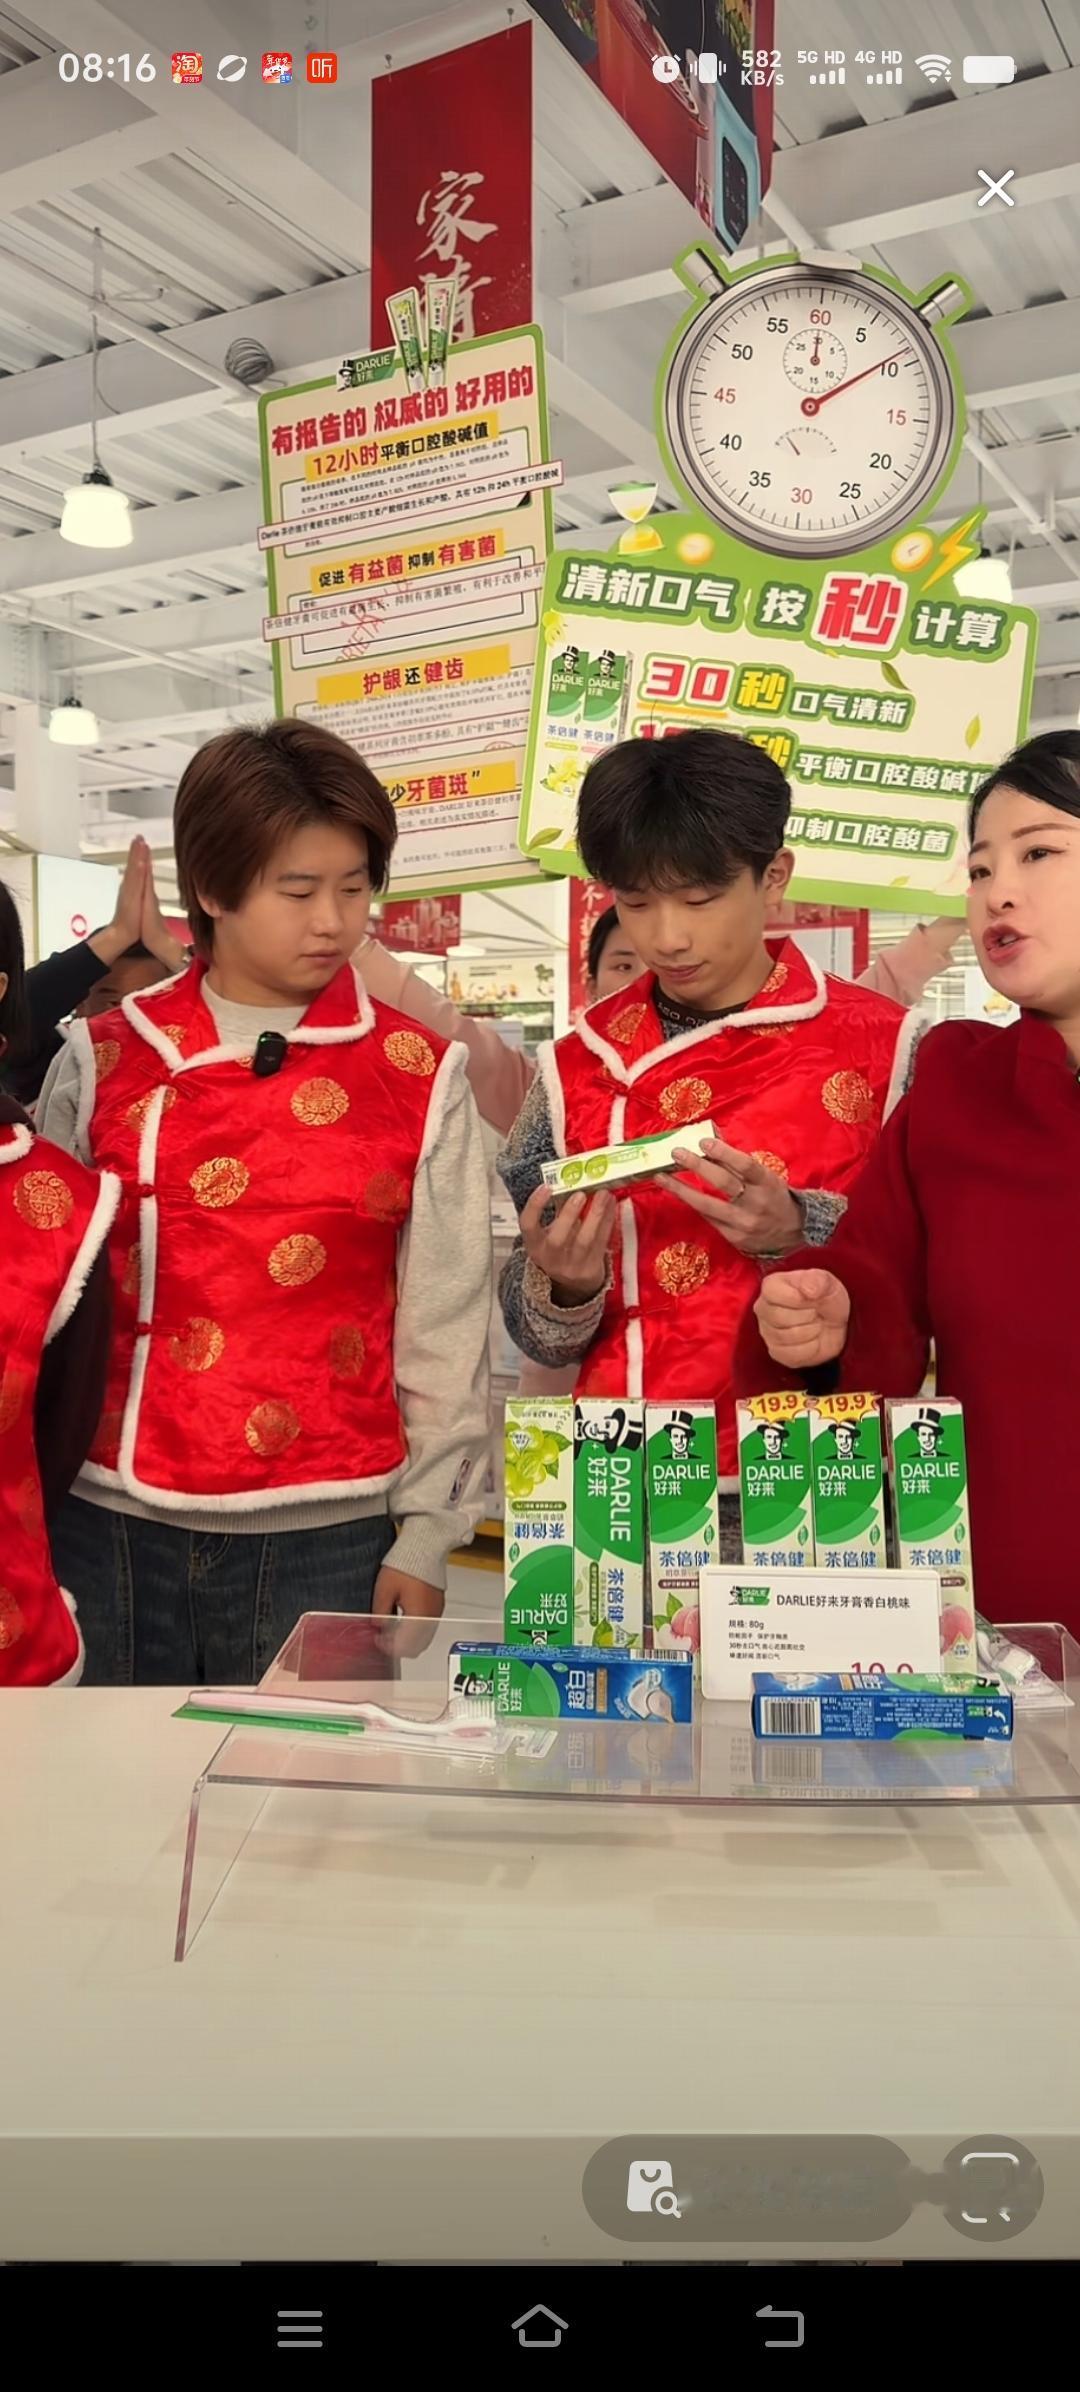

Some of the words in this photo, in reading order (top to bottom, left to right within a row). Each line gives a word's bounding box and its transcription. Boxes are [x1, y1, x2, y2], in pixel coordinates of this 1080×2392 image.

[766, 317, 789, 334] 55
[810, 309, 831, 325] 60
[855, 327, 867, 343] 5
[731, 344, 754, 361] 50
[796, 343, 806, 351] 25
[355, 354, 391, 372] DARLIE
[793, 366, 804, 375] 20
[879, 361, 899, 378] 10
[809, 376, 819, 385] 15
[825, 370, 834, 379] 10
[713, 387, 736, 404] 45
[271, 406, 367, 456] 有报告的
[373, 385, 449, 432] 权威的
[454, 365, 534, 412] 好用的
[887, 408, 907, 425] 15
[313, 421, 490, 476] 12小时平衡口腔酸碱值
[719, 433, 742, 451] 40
[869, 452, 892, 470] 20
[749, 470, 771, 488] 35
[790, 487, 813, 505] 30
[839, 482, 862, 499] 25
[318, 569, 346, 588] 促进
[348, 556, 404, 584] 有益菌
[407, 550, 435, 570] 抑制
[438, 535, 496, 565] 有害菌
[562, 563, 733, 620] 清新口气
[760, 586, 808, 627] 按
[817, 576, 901, 647] 秒
[916, 605, 1002, 649] 计算
[363, 658, 464, 695] 护龈还健齿
[552, 674, 584, 687] DARLIE
[588, 678, 621, 691] DARLIE
[547, 724, 579, 739] 茶倍健
[755, 1394, 799, 1414] 19.9
[824, 1394, 867, 1413] 19.9
[587, 1456, 607, 1498] 好来
[652, 1464, 711, 1480] DARLIE
[746, 1465, 805, 1480] DARLIE
[817, 1464, 876, 1480] DARLIE
[900, 1462, 960, 1478] DARLIE
[653, 1480, 682, 1496] 好来
[747, 1481, 776, 1497] 好来
[818, 1481, 847, 1497] 好来
[901, 1479, 931, 1495] 好来
[609, 1456, 632, 1542] DARLIE
[514, 1522, 565, 1539] 茶倍健
[659, 1550, 711, 1568] 茶倍健
[753, 1551, 805, 1568] 茶倍健
[825, 1551, 877, 1568] 茶倍健
[909, 1549, 961, 1566] 茶倍健
[540, 1592, 567, 1609] 好来
[607, 1567, 625, 1623] 茶倍健
[742, 1588, 767, 1597] DARLIE
[776, 1594, 911, 1609] DARLIE好来牙膏香白桃味
[510, 1609, 568, 1625] DARLIE
[749, 1620, 765, 1631] 80g
[497, 1662, 510, 1712] DARLIE
[568, 1669, 586, 1710] 超白
